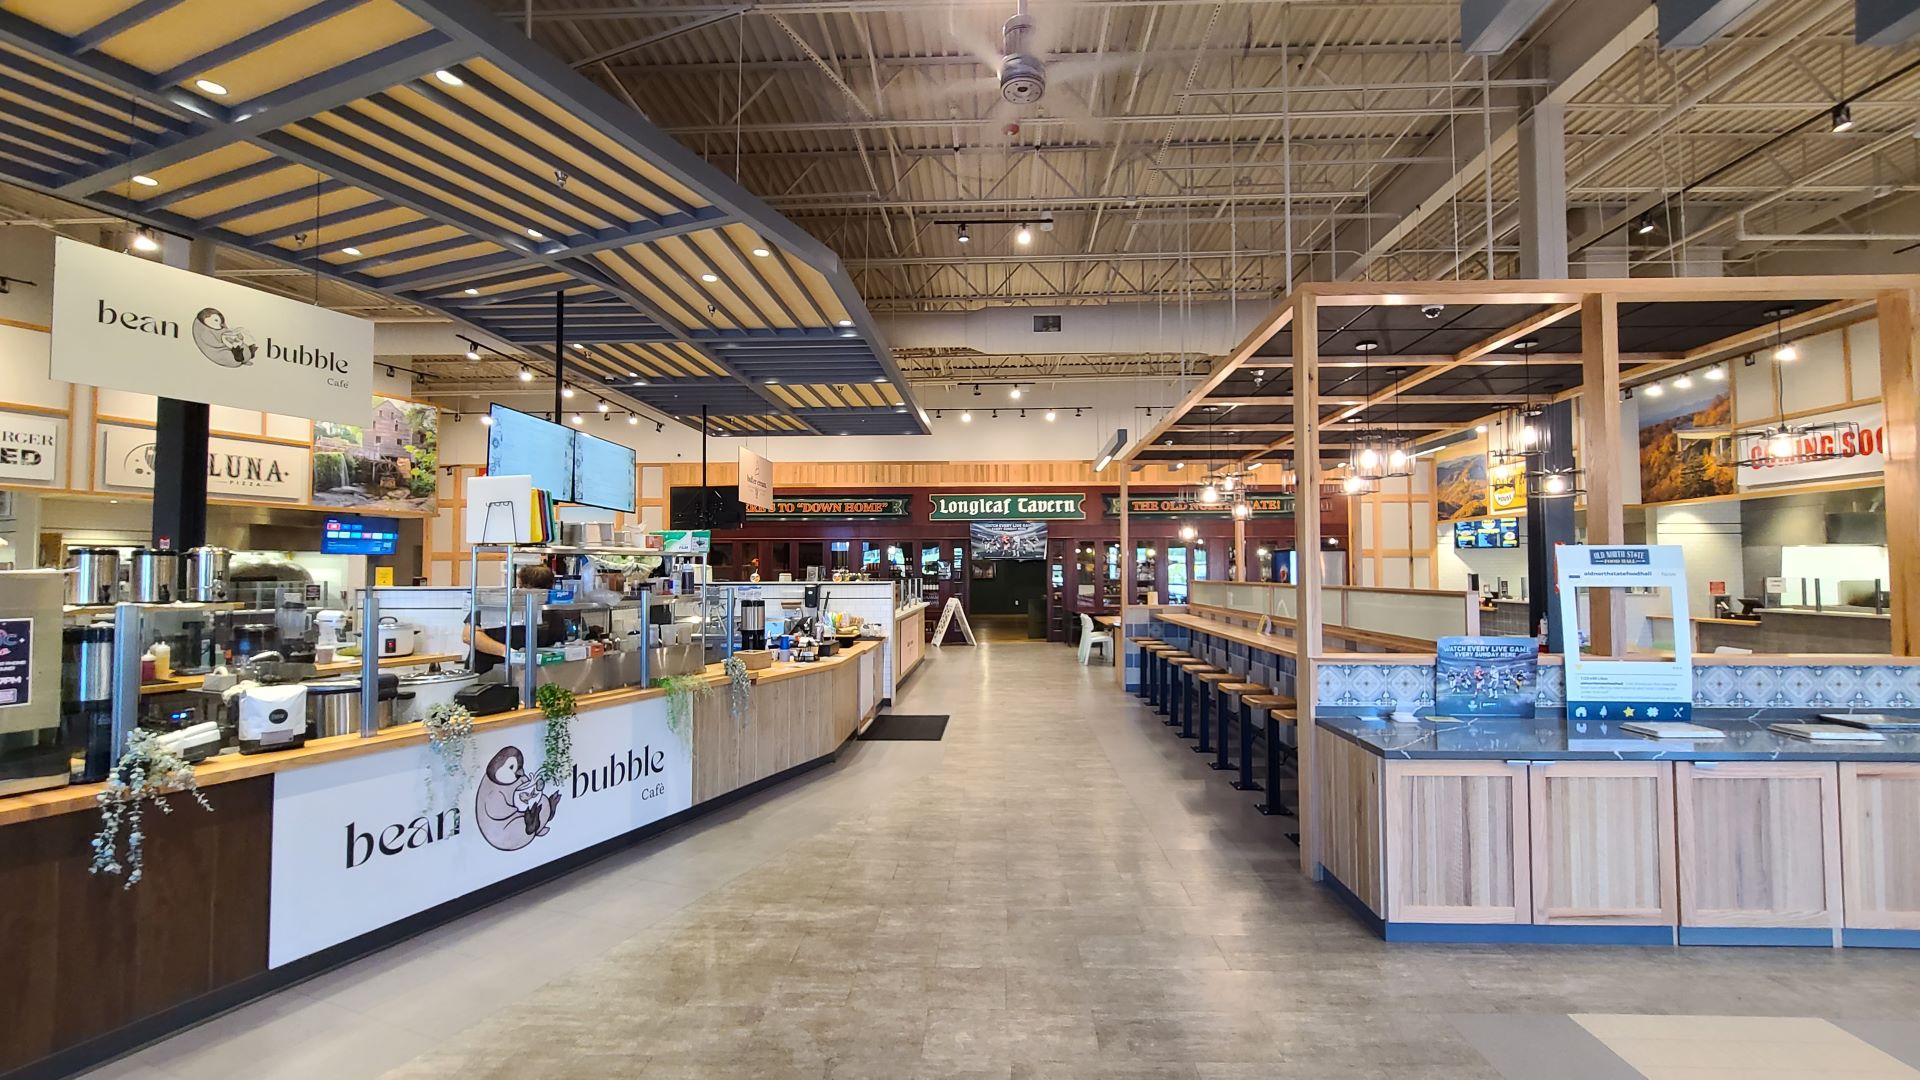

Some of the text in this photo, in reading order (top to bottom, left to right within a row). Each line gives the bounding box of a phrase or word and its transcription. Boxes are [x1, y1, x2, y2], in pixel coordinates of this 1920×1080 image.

[97, 299, 349, 374] bean bubble
[209, 452, 284, 483] LUNA
[1750, 434, 1834, 470] COING
[779, 502, 796, 513] TO
[939, 497, 1076, 515] Longleaf Tavern
[1132, 500, 1159, 511] THE
[1161, 500, 1186, 511] OLD
[346, 745, 665, 869] bean bubble
